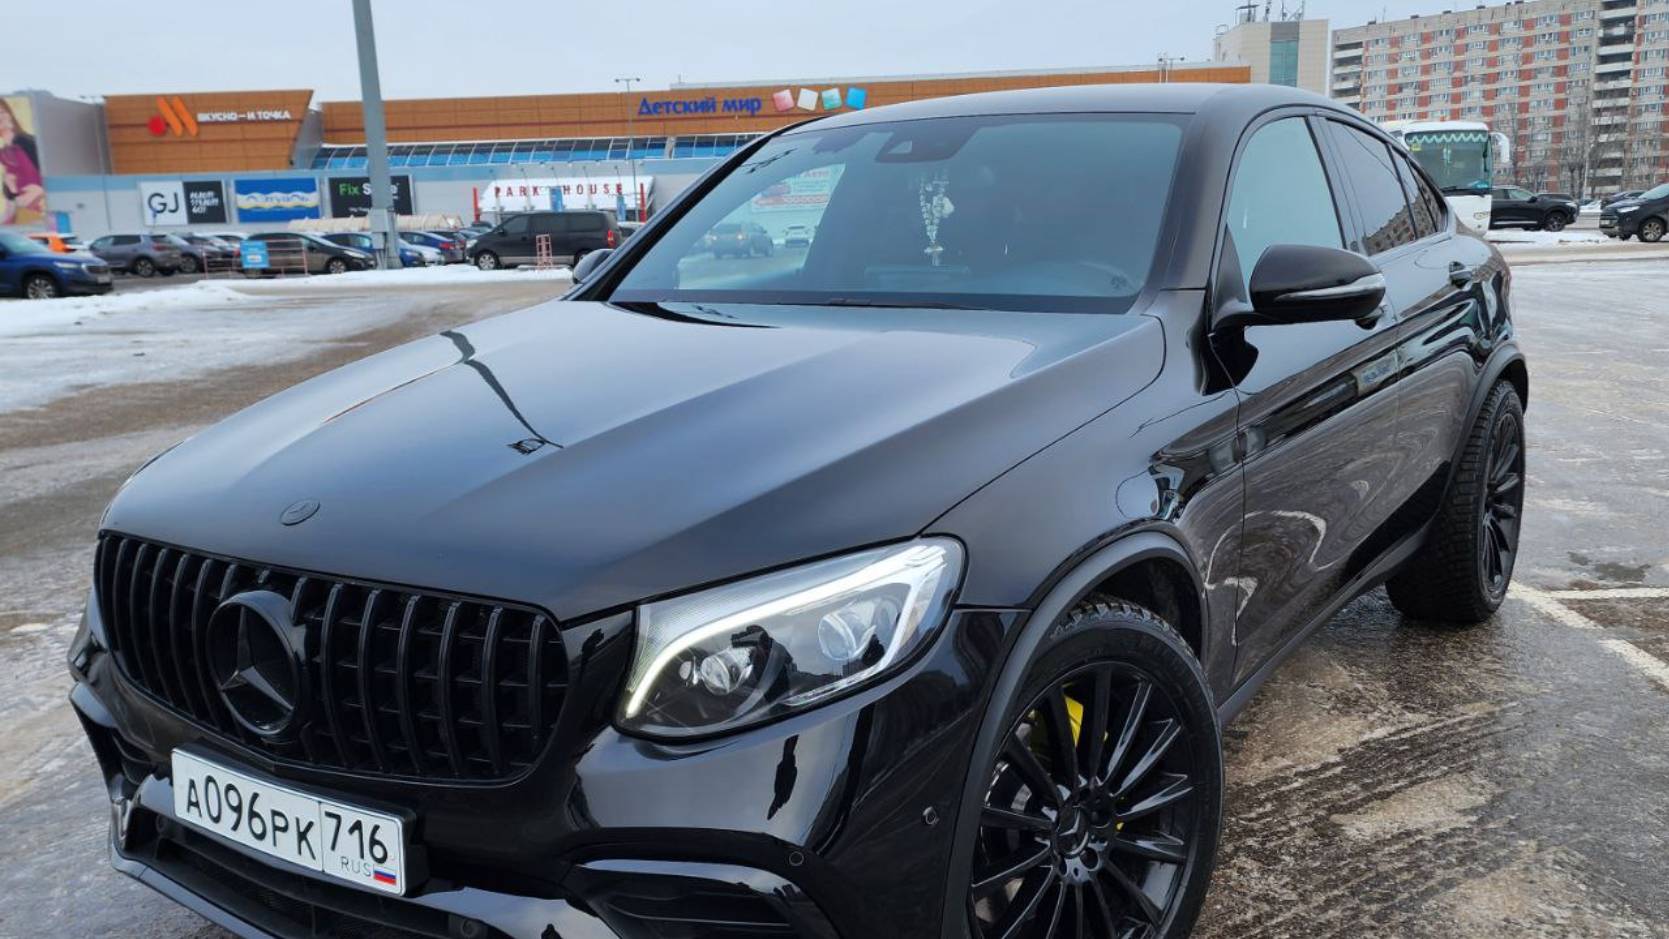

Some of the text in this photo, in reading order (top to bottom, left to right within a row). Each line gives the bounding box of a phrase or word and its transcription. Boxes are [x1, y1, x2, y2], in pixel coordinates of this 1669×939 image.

[638, 96, 763, 116] Детский мир
[339, 183, 359, 196] Fix
[494, 183, 622, 198] PARK HOUSE
[148, 192, 179, 214] GJ
[325, 811, 388, 864] 716
[341, 855, 372, 877] RUS
